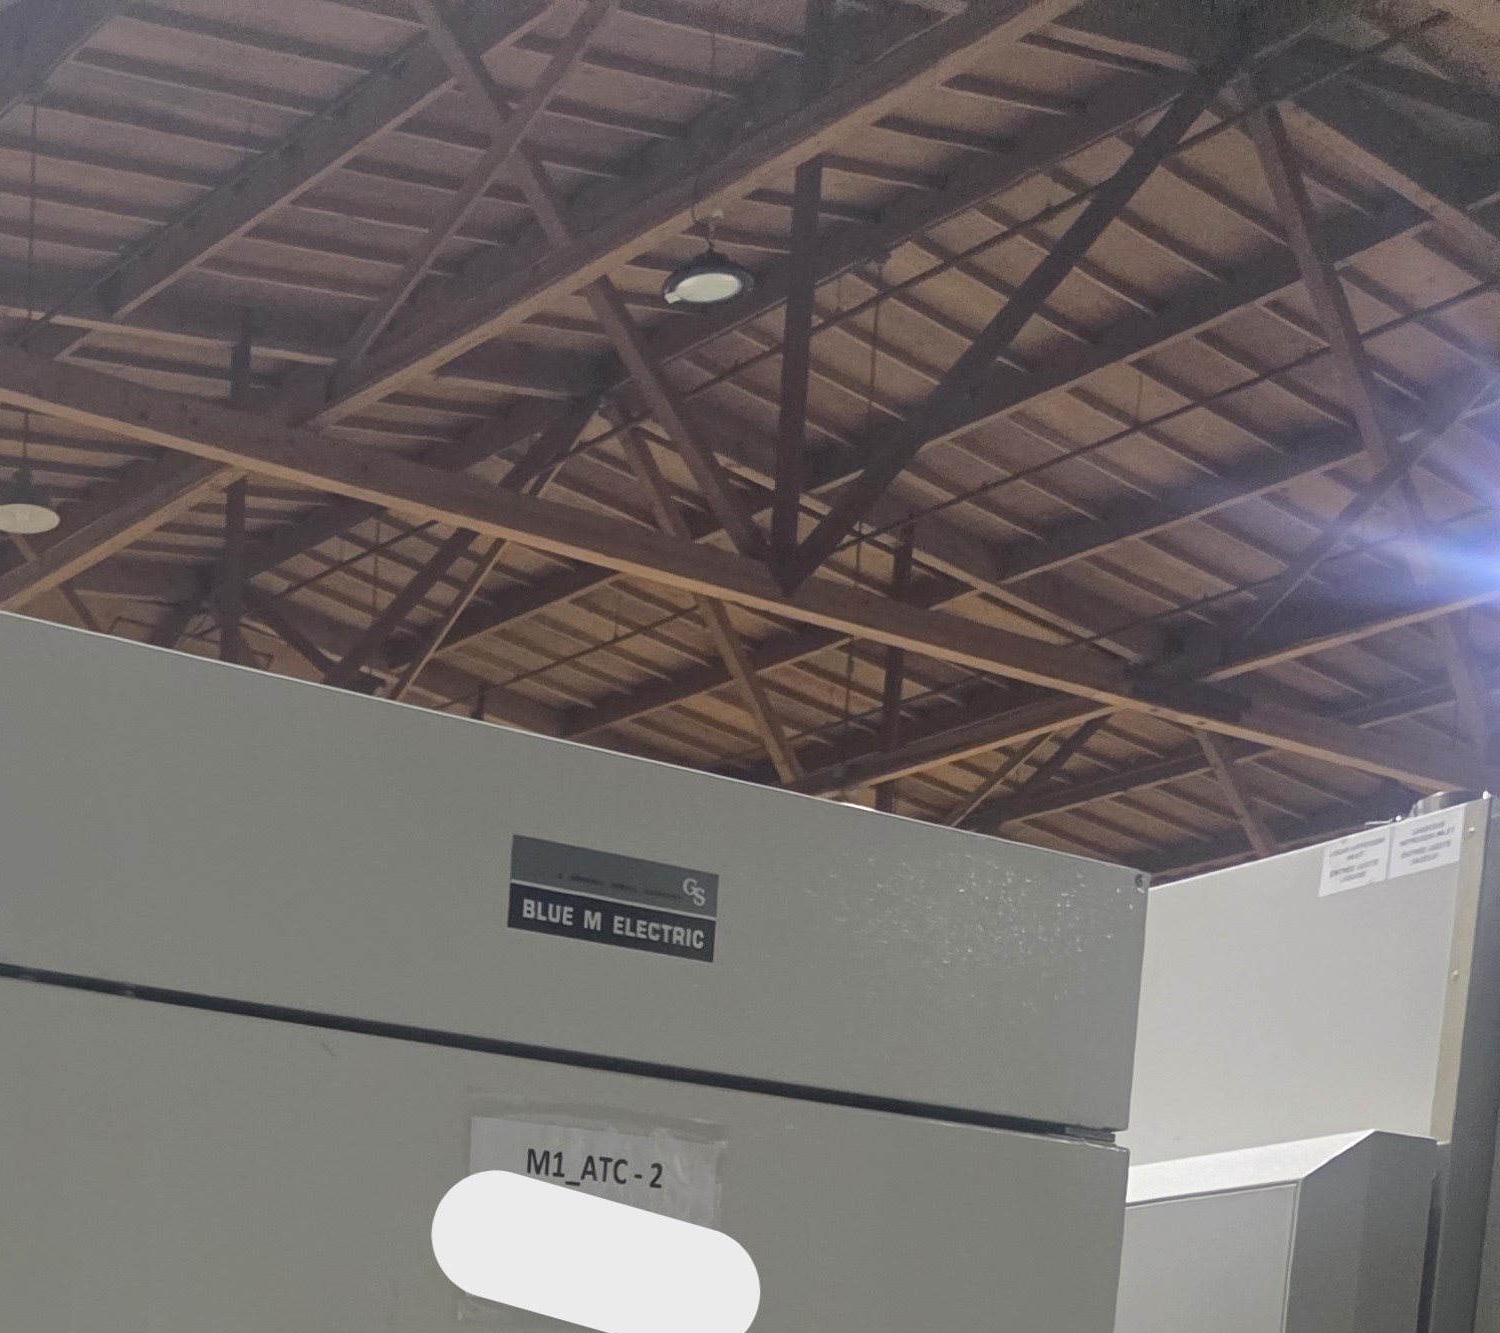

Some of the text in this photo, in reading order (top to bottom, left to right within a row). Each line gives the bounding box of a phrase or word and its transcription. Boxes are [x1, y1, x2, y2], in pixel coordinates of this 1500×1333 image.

[522, 898, 704, 950] BLUE M ELECTRIC
[526, 1148, 629, 1186] M1_ATC
[649, 1162, 663, 1189] 2
